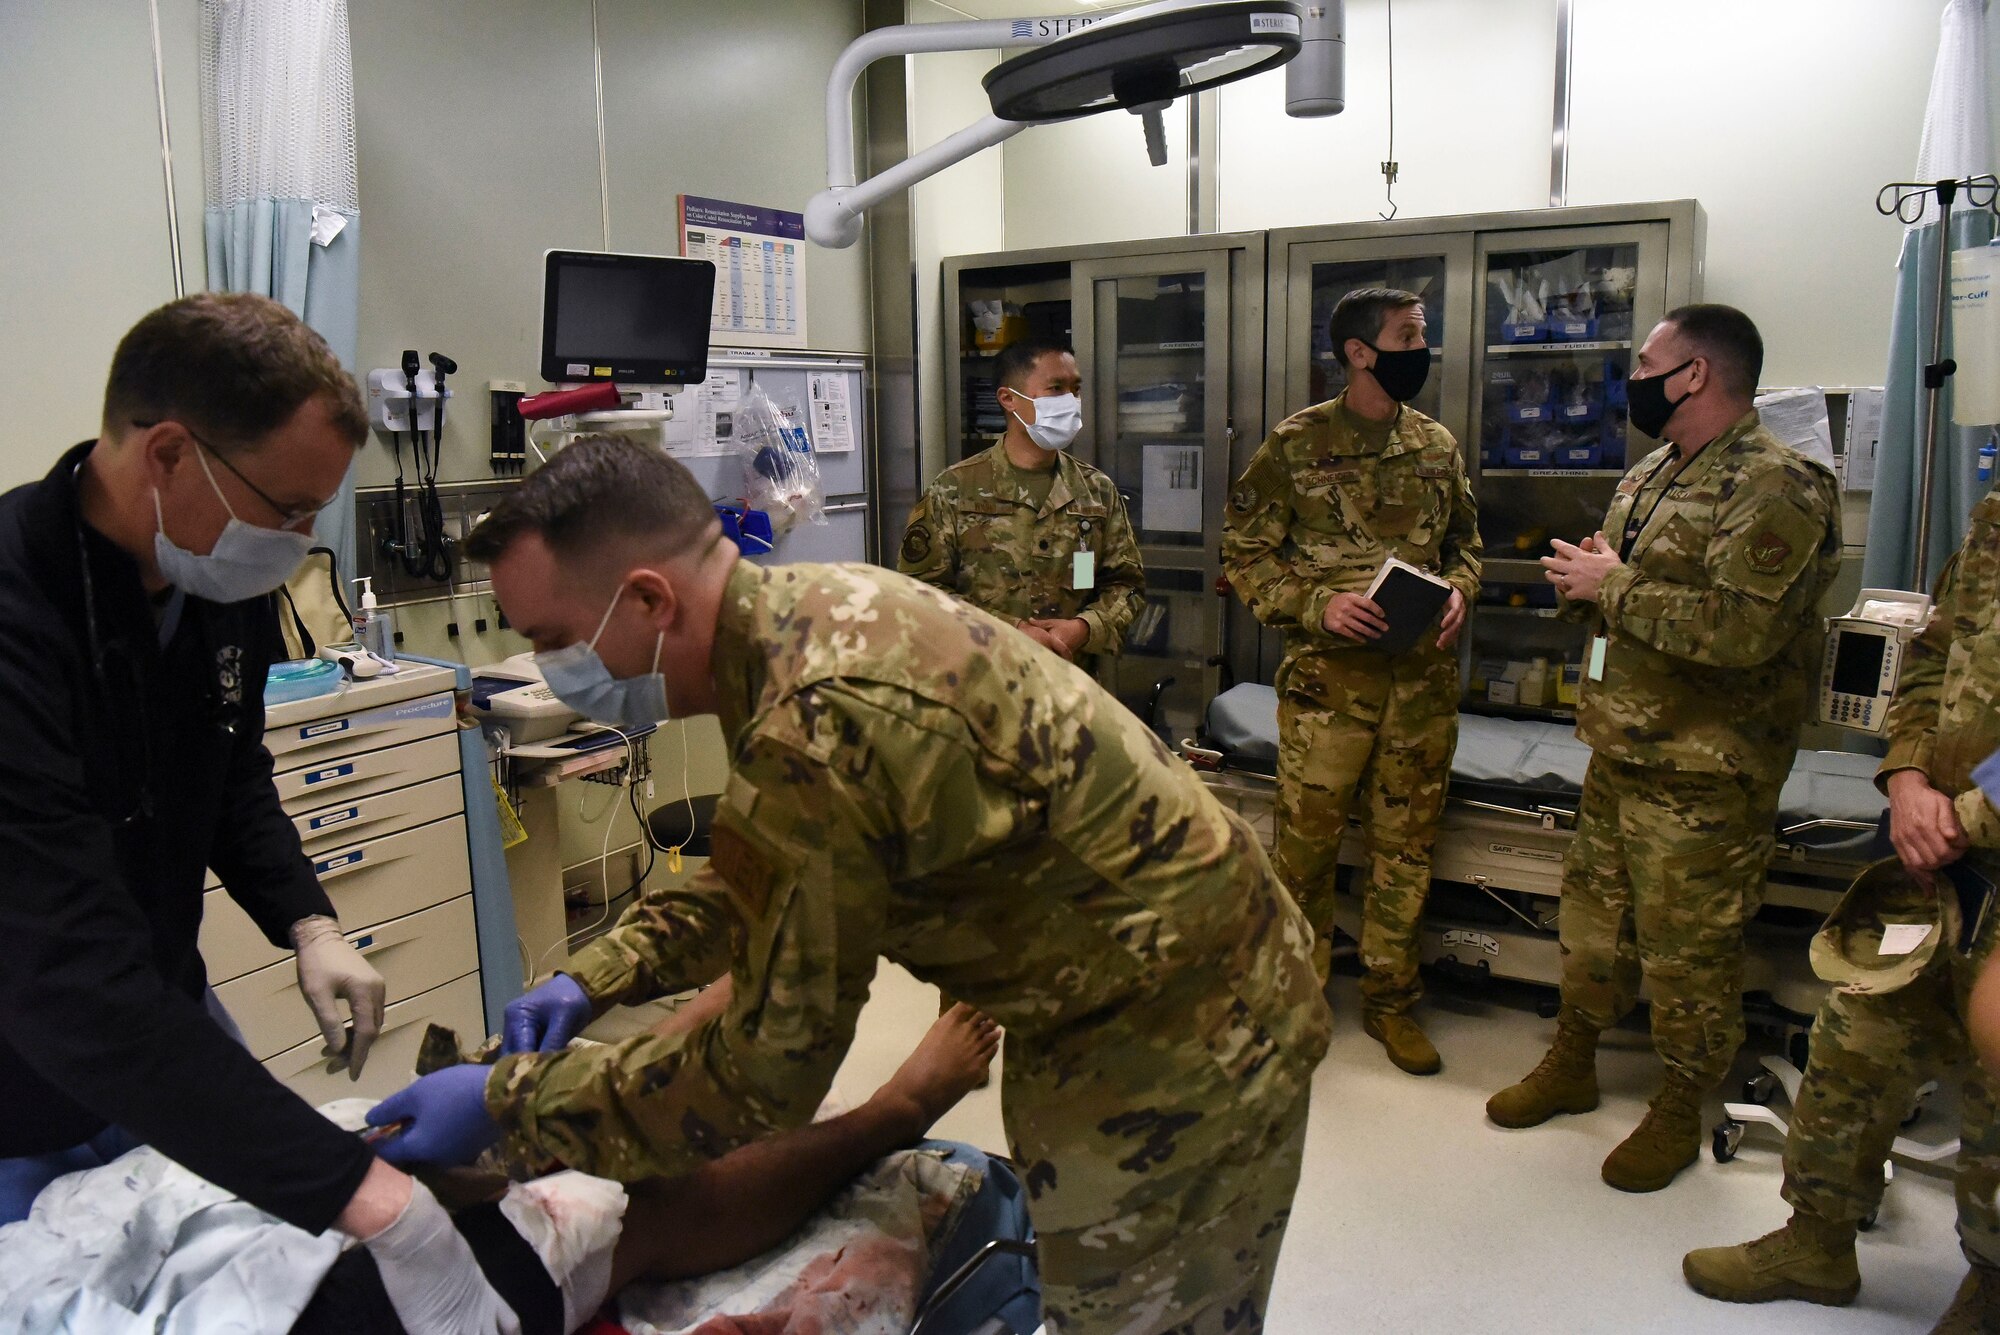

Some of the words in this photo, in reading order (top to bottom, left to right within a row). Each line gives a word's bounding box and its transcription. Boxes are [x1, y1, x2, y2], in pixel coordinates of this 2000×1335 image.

[1261, 18, 1284, 28] STERIS
[1305, 470, 1355, 486] SCHNEIDER
[394, 700, 450, 716] Procedure
